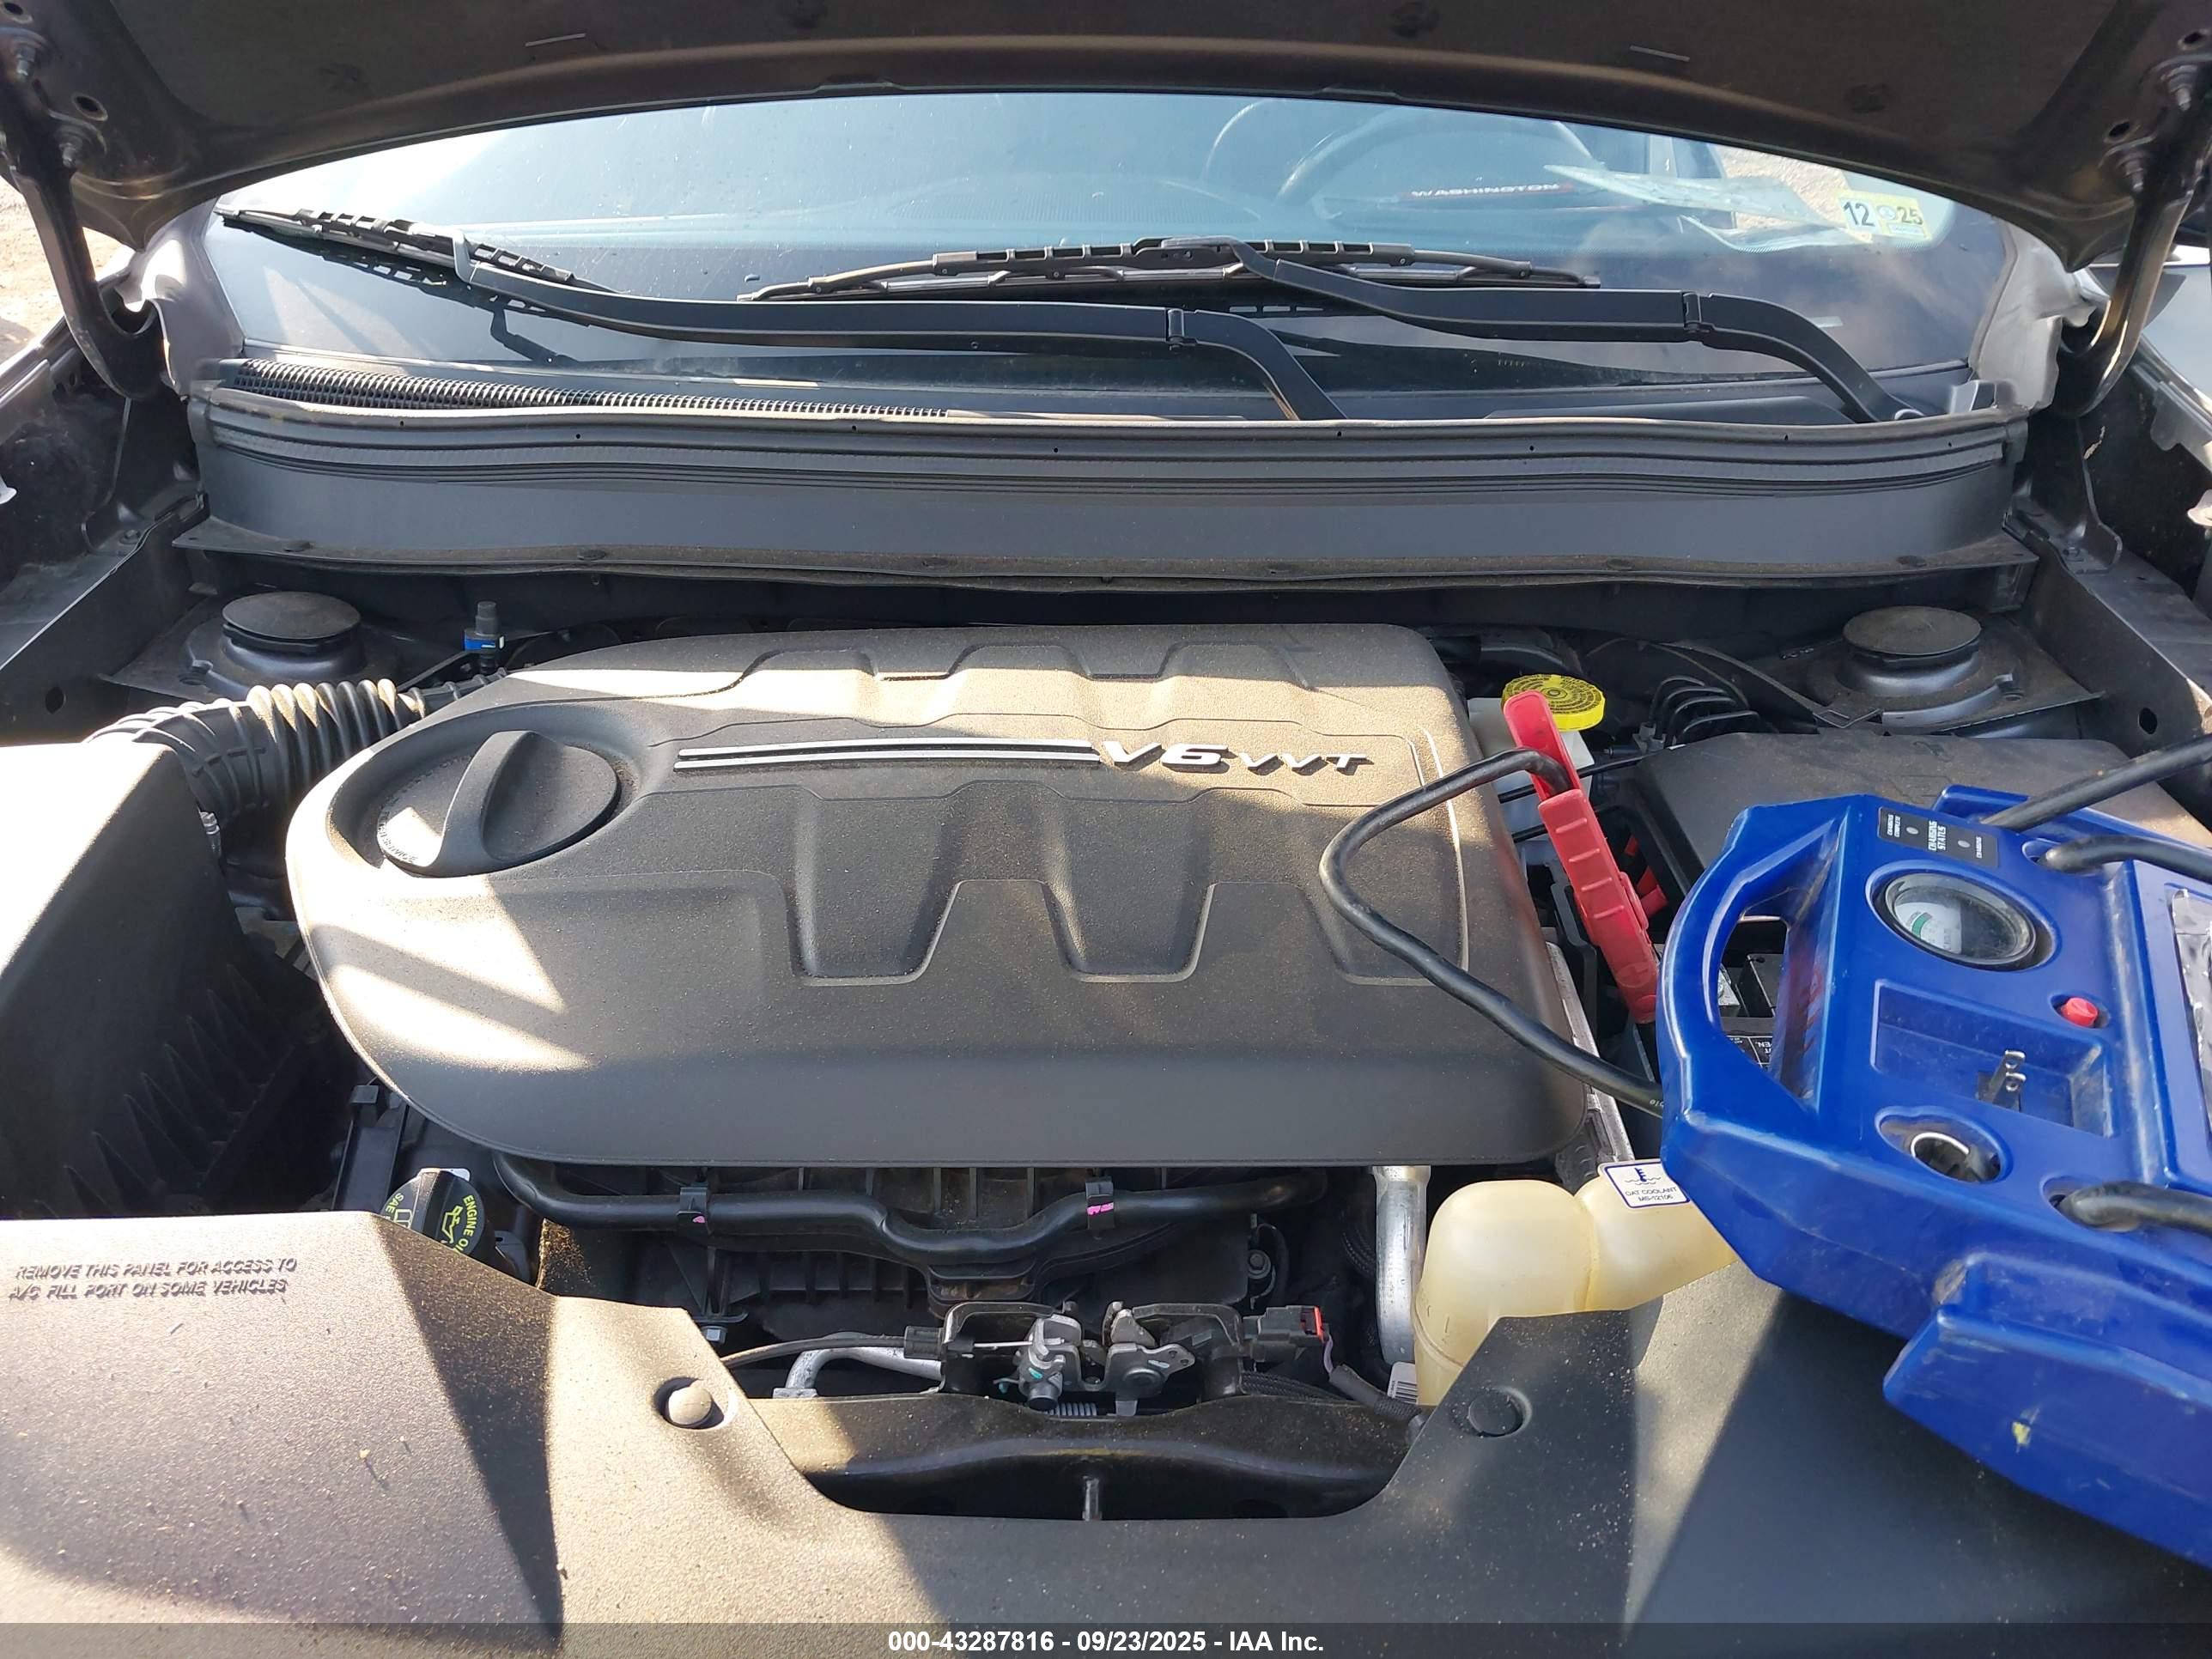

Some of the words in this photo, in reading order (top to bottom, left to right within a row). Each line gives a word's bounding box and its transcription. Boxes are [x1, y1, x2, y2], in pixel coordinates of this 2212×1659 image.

[1843, 201, 1875, 228] 12
[1896, 206, 1923, 226] 25
[1102, 740, 1231, 770] V6
[1237, 751, 1370, 775] VVT
[386, 1193, 404, 1214] SAE
[463, 1194, 477, 1237] ENGINE
[15, 1264, 82, 1280] REMOVE
[85, 1263, 121, 1279] THIS
[123, 1262, 171, 1278] PANEL
[176, 1261, 209, 1276] FOR
[210, 1259, 274, 1275] ACCESS
[278, 1257, 298, 1273] TO
[8, 1284, 42, 1302] A/C
[46, 1284, 78, 1300] FILL
[83, 1283, 128, 1299] PORT
[131, 1282, 158, 1298] ON
[160, 1280, 208, 1297] SOME
[213, 1278, 289, 1295] VEHICLES
